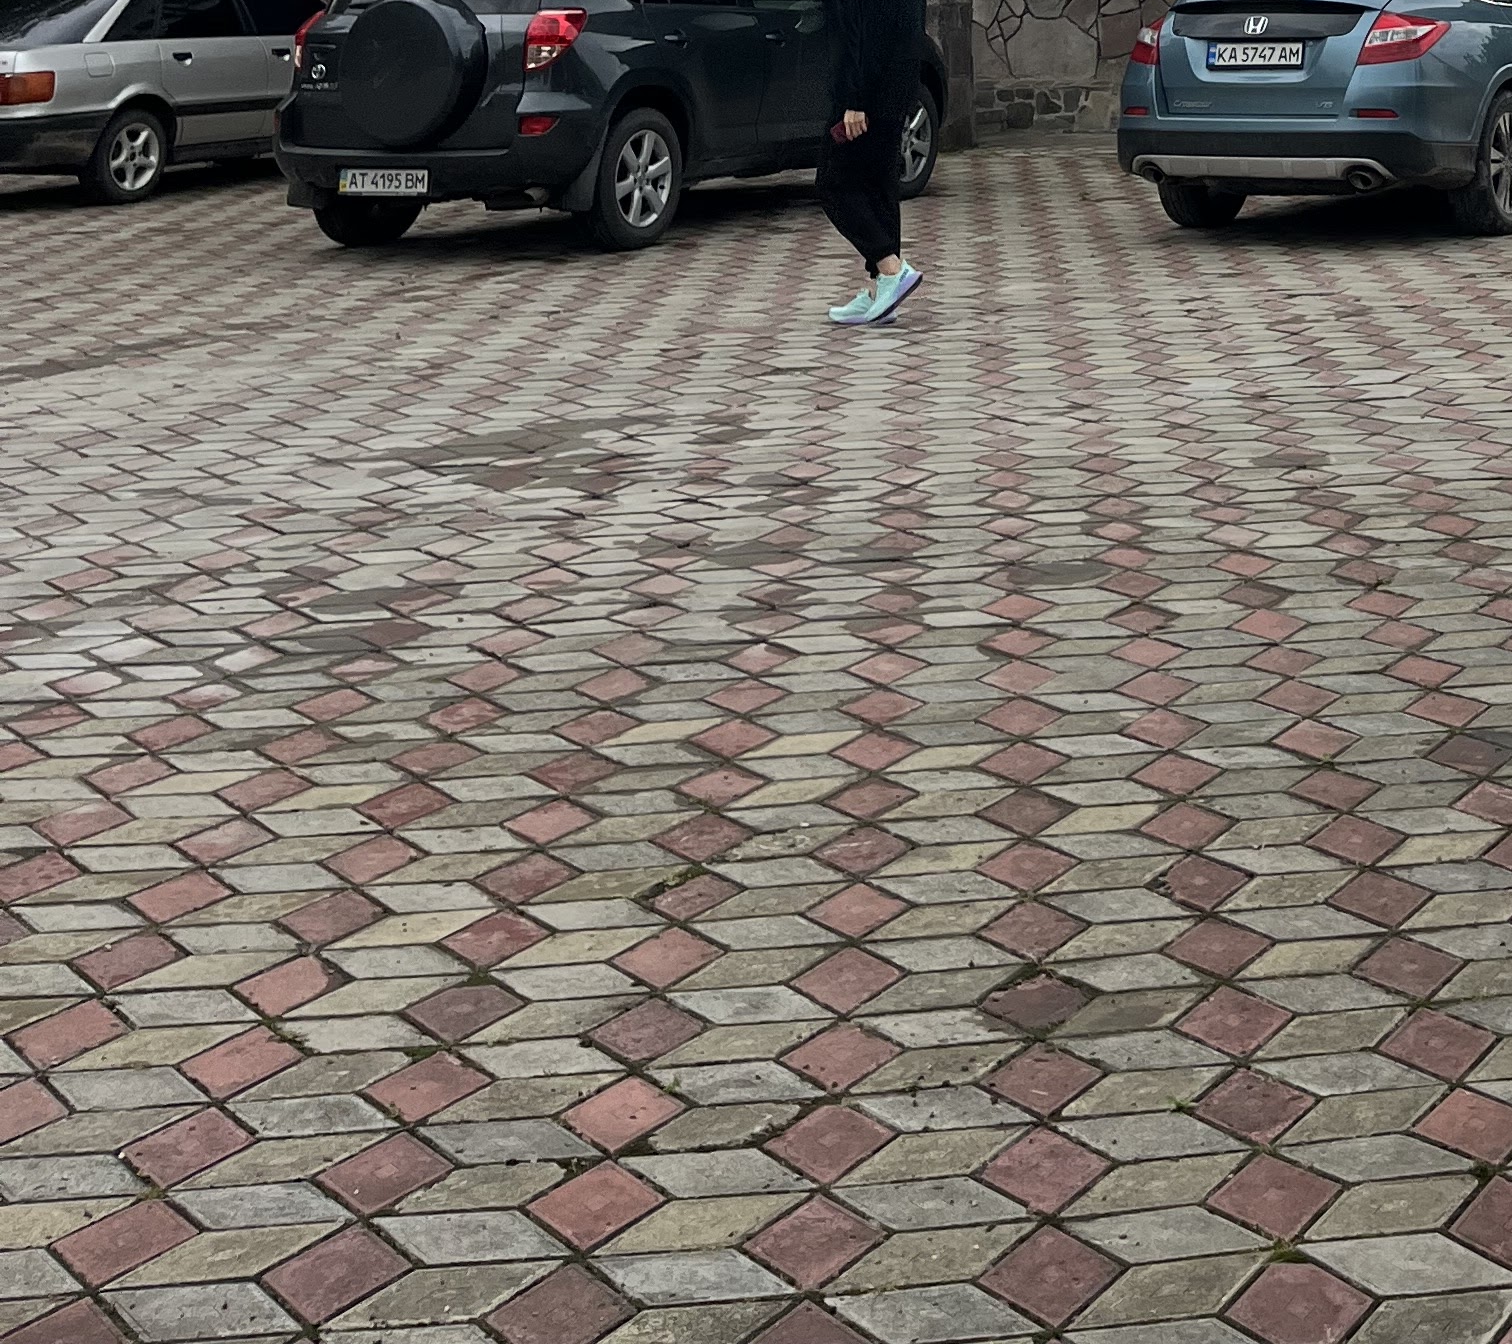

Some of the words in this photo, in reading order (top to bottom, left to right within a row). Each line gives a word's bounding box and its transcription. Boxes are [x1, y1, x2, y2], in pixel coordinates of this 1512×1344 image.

[1217, 47, 1238, 63] KA
[1241, 47, 1276, 63] 5747
[1278, 47, 1300, 63] AM
[349, 172, 369, 189] AT
[371, 172, 402, 190] 4195
[404, 173, 426, 189] BM
